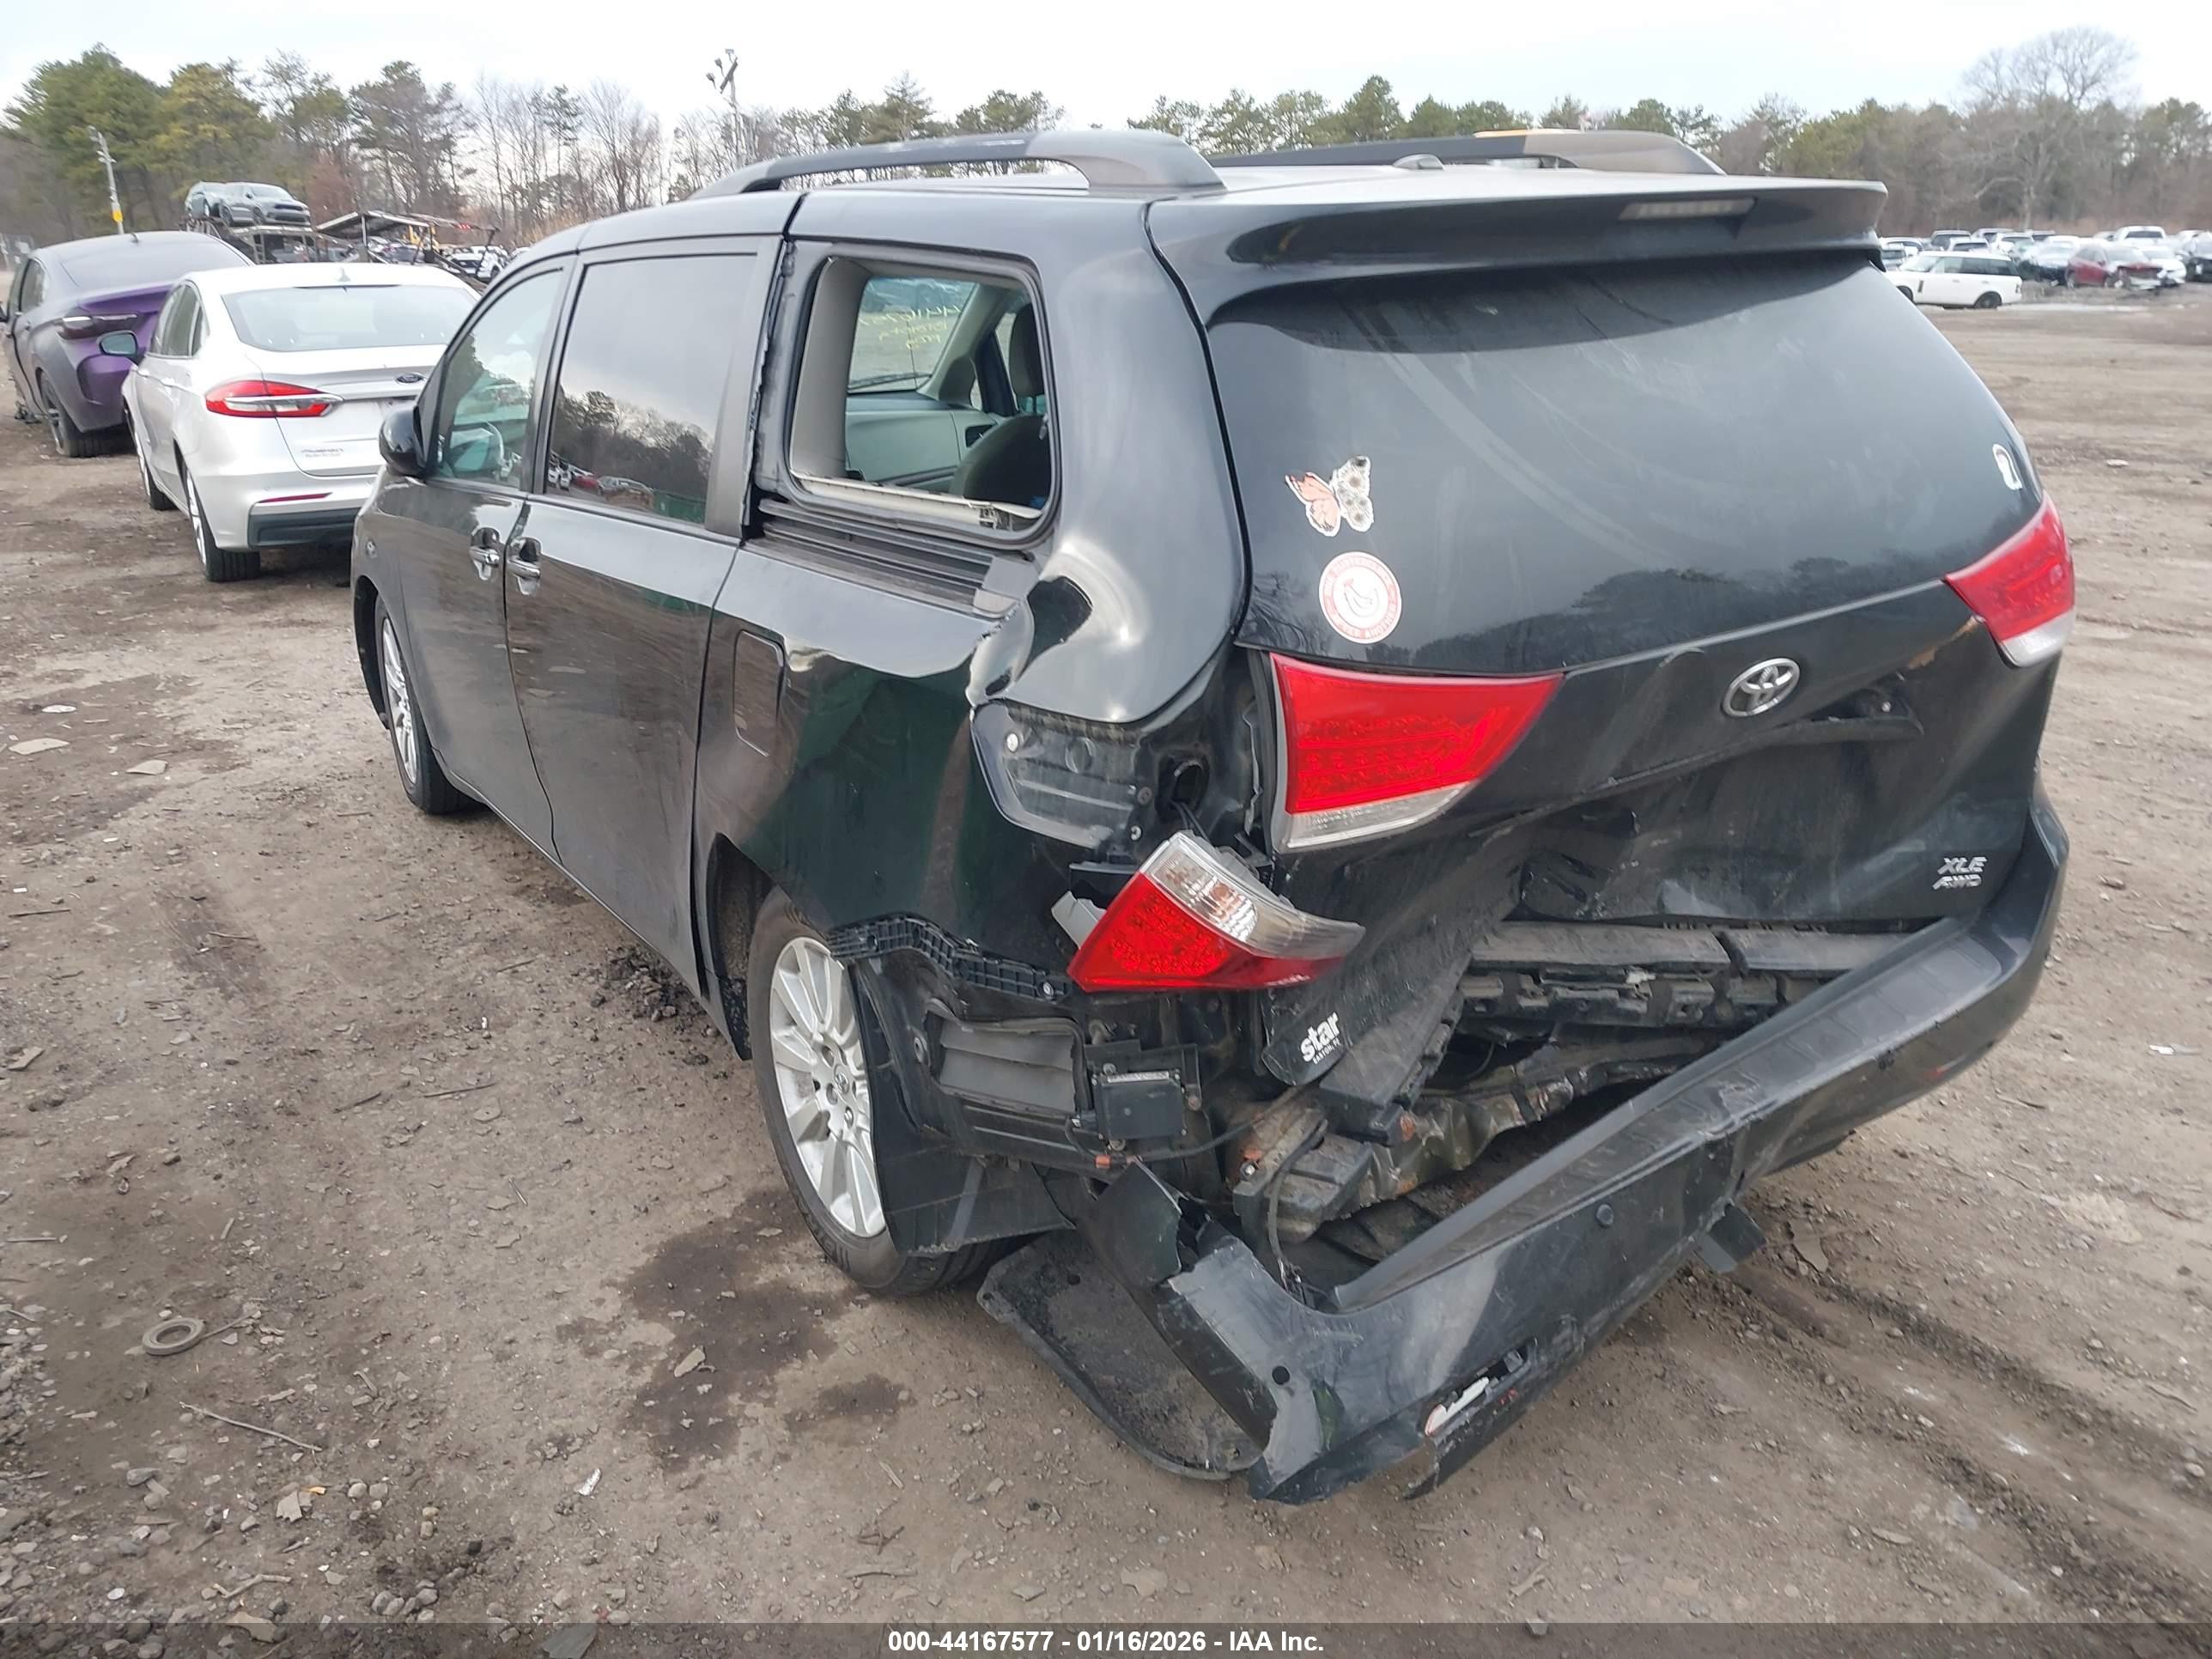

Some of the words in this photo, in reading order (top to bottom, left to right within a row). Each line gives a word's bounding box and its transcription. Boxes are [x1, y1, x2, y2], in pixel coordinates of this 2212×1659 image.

[1937, 857, 1987, 874] XLE
[1932, 874, 1982, 890] AWD
[1301, 1012, 1340, 1062] star
